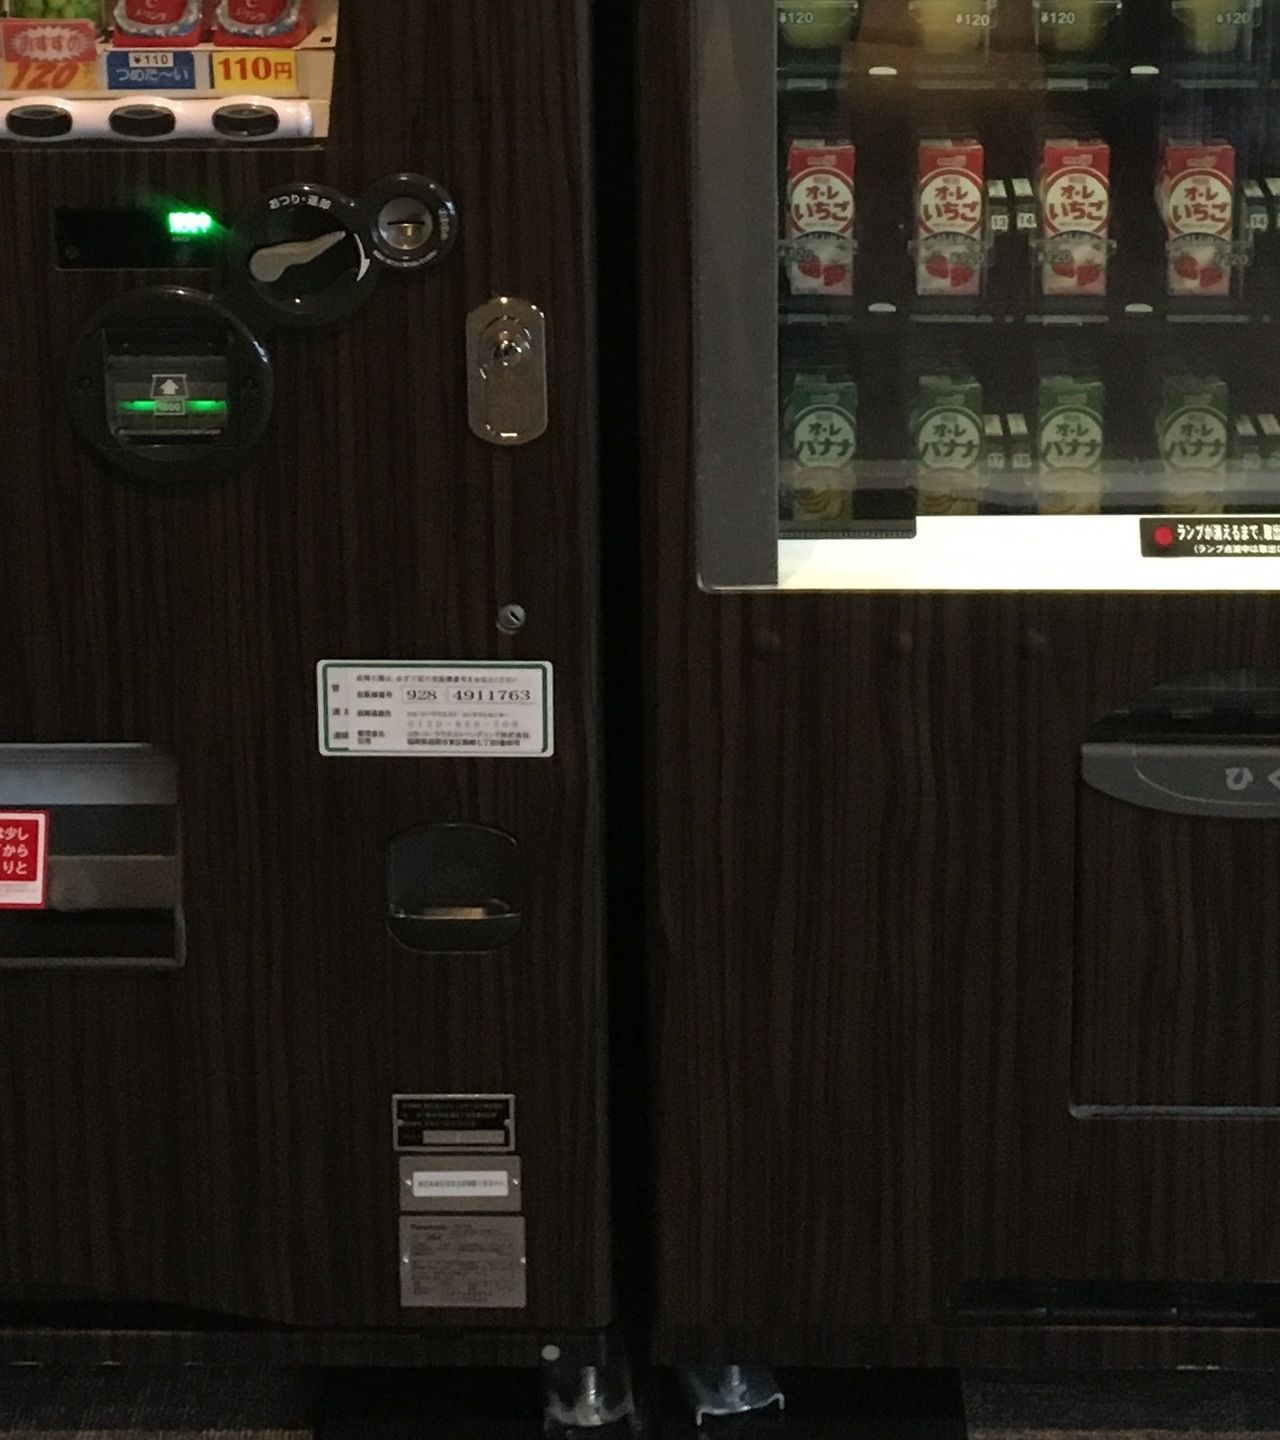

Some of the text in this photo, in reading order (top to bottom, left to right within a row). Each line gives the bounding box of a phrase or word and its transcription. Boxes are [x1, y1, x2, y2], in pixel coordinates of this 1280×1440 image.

[11, 61, 80, 90] 120
[218, 56, 293, 82] 110円
[795, 201, 850, 222] いちご
[923, 201, 978, 222] いちご
[1049, 201, 1106, 222] いちご
[1172, 203, 1229, 223] いちご
[797, 441, 852, 457] バナナ
[921, 440, 977, 458] バナナ
[1044, 440, 1100, 458] バナナ
[1170, 440, 1225, 457] バナナ
[406, 689, 532, 701] 928 4911763
